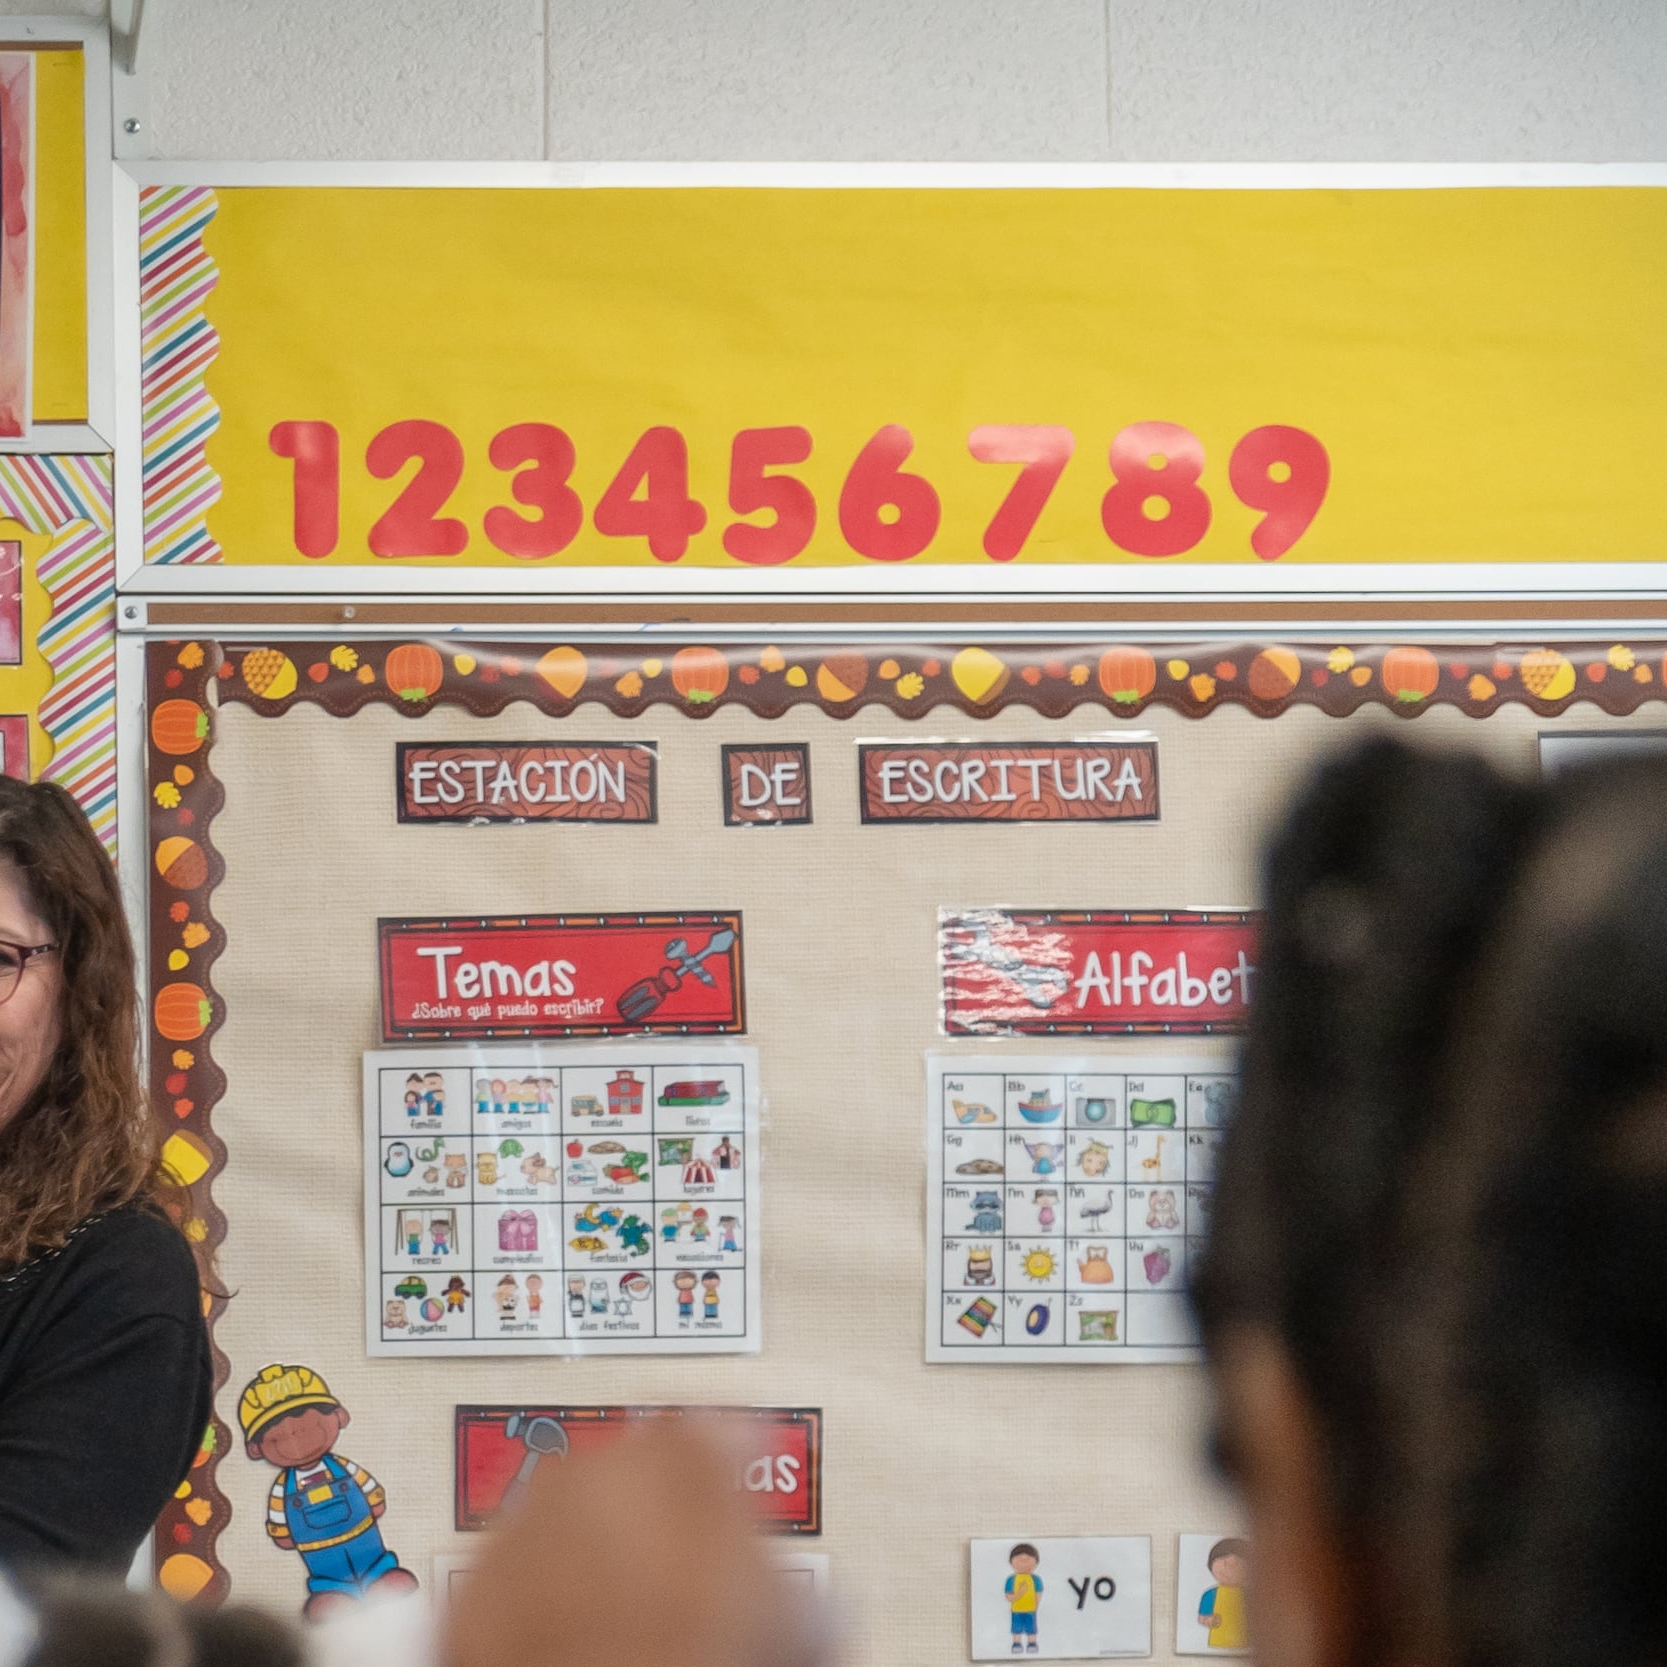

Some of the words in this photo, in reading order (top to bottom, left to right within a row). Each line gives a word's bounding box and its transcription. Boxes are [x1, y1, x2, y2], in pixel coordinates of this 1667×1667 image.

[409, 755, 627, 804] ESTACIÓN
[741, 761, 801, 808] DE
[877, 757, 1143, 804] ESCRITURA
[417, 946, 576, 999] Temas
[1076, 951, 1257, 1008] Alfabet
[411, 1002, 461, 1021] ¿Sobre
[468, 1000, 492, 1020] qué
[498, 1003, 538, 1020] puedo
[543, 998, 604, 1019] escribir?
[1068, 1576, 1116, 1610] yo
